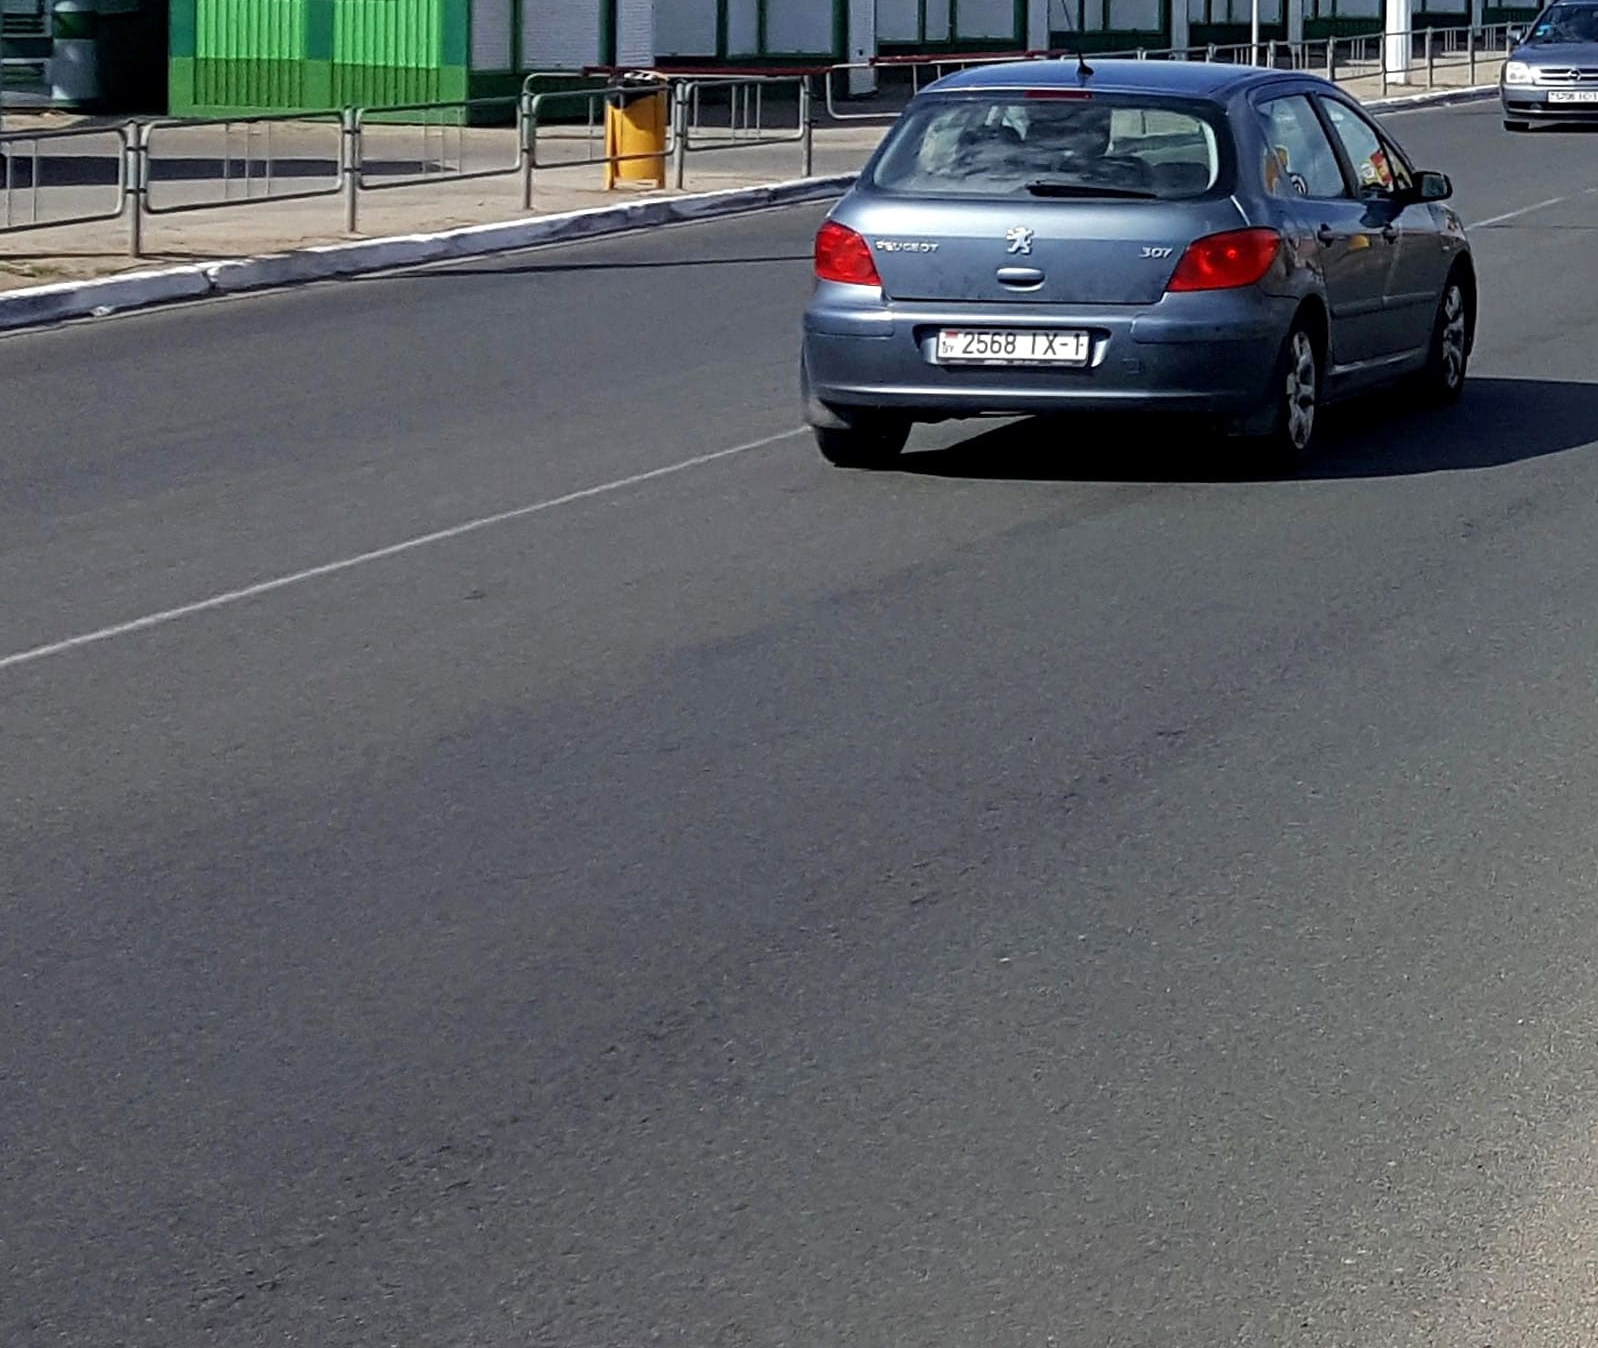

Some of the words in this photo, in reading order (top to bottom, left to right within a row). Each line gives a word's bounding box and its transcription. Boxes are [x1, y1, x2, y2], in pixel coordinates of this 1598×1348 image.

[875, 240, 939, 253] PEUGEOT
[1138, 246, 1173, 259] 307
[962, 332, 1017, 354] 2568
